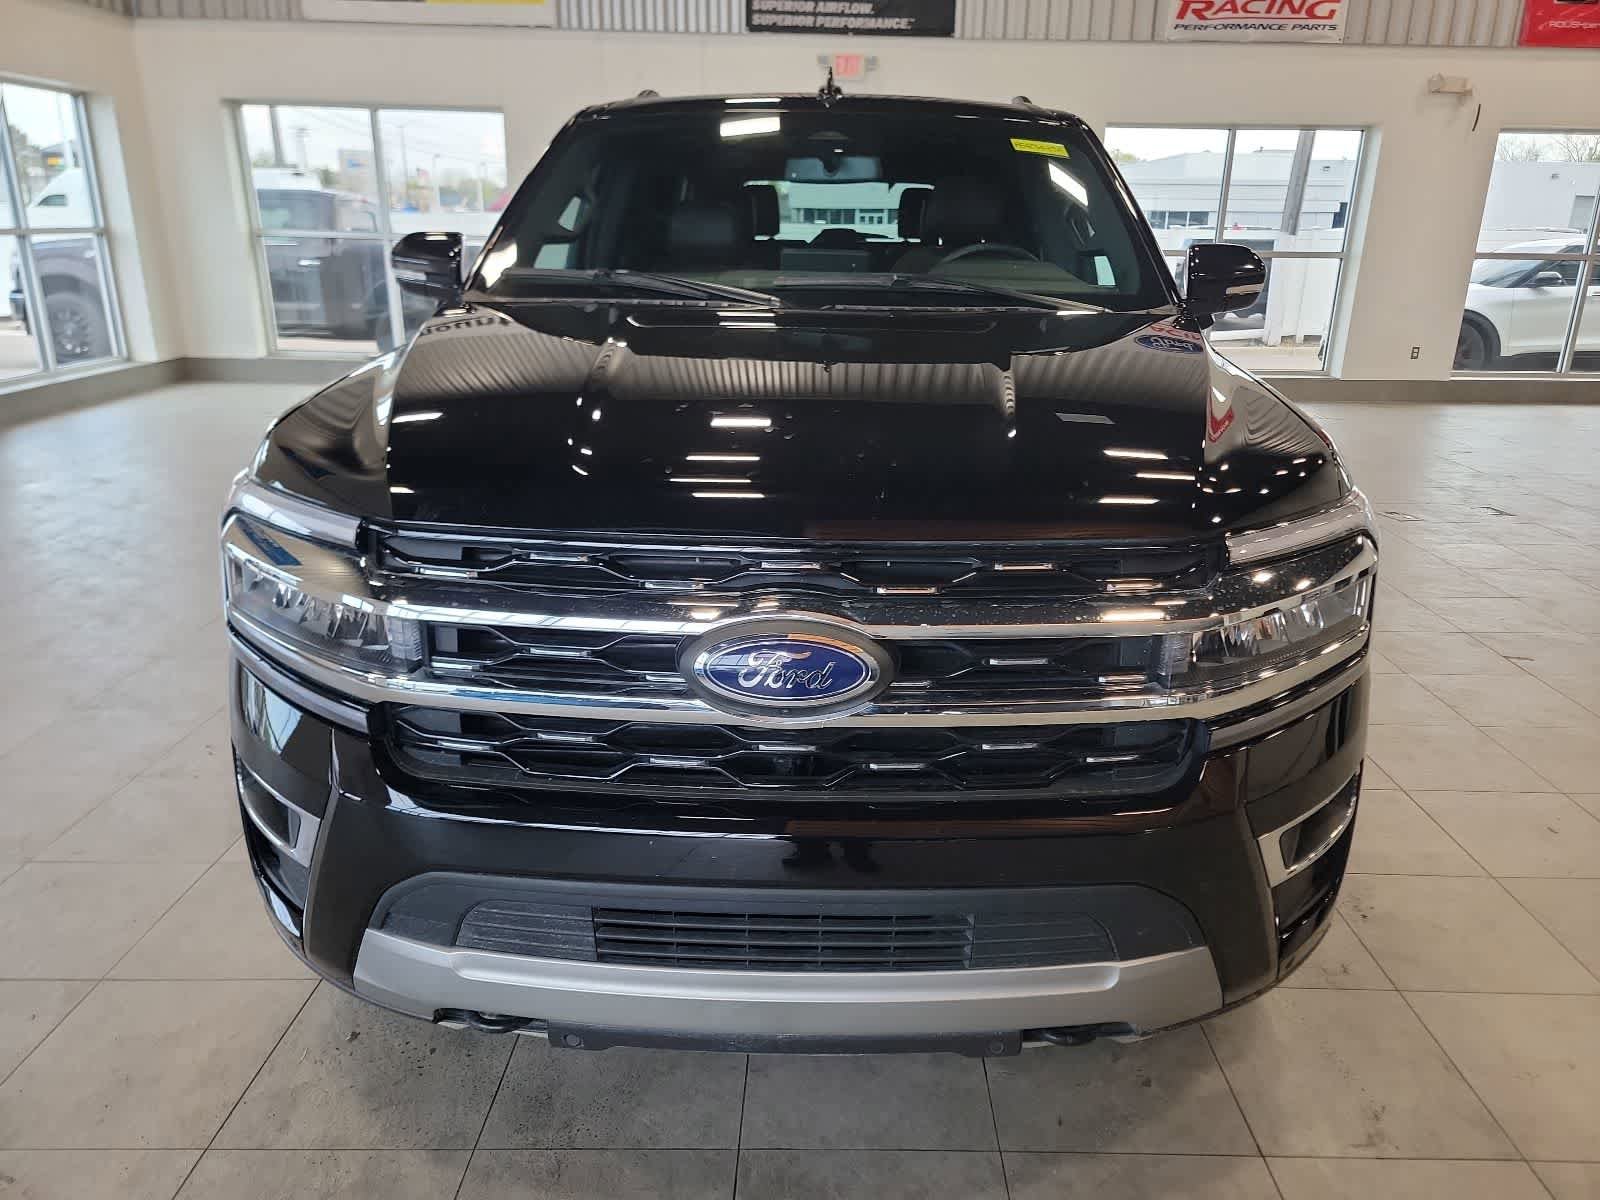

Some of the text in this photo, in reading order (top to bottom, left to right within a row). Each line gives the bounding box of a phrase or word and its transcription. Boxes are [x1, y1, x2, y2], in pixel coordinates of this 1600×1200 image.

[752, 0, 815, 12] SUPERIOR
[1176, 0, 1341, 20] RACING
[752, 15, 815, 27] SUPERIOR
[1173, 23, 1291, 31] PERFORMANCE
[738, 649, 837, 689] Ford
